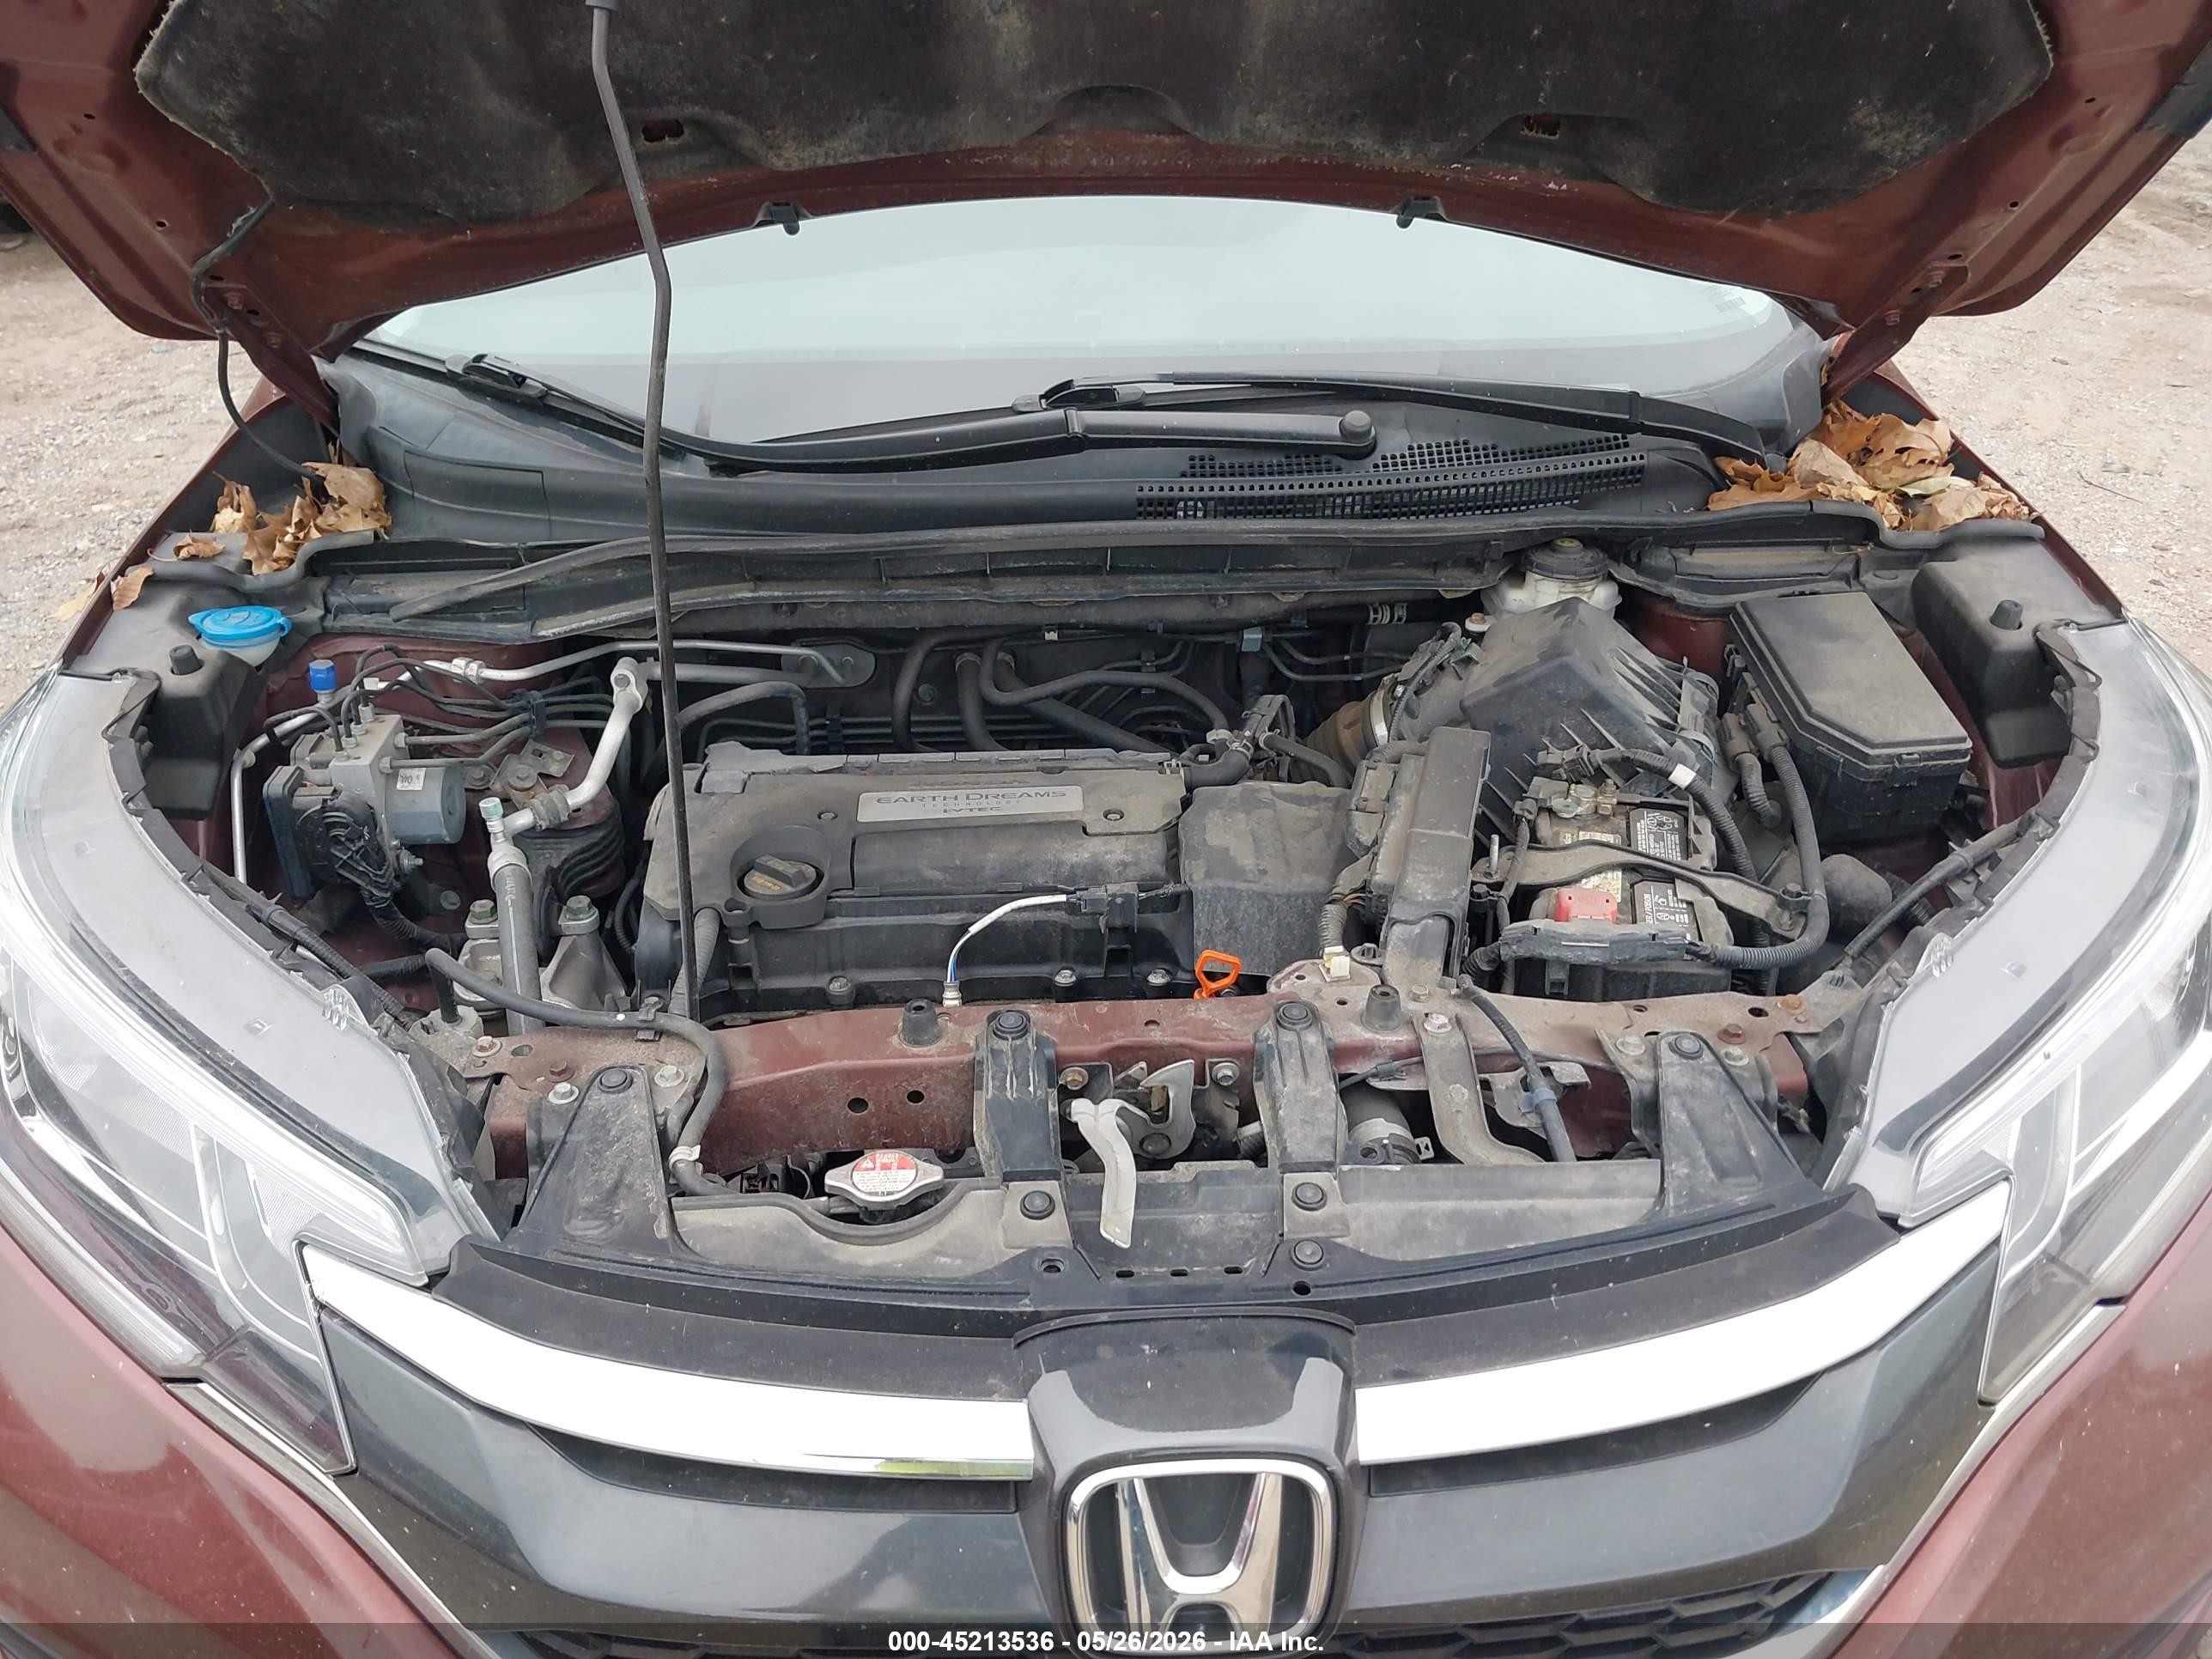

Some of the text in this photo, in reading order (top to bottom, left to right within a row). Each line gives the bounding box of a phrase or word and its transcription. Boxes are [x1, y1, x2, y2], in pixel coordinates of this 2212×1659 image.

[876, 790, 1067, 804] EARTH DREAMS
[1644, 893, 1653, 924] ER/POISON
